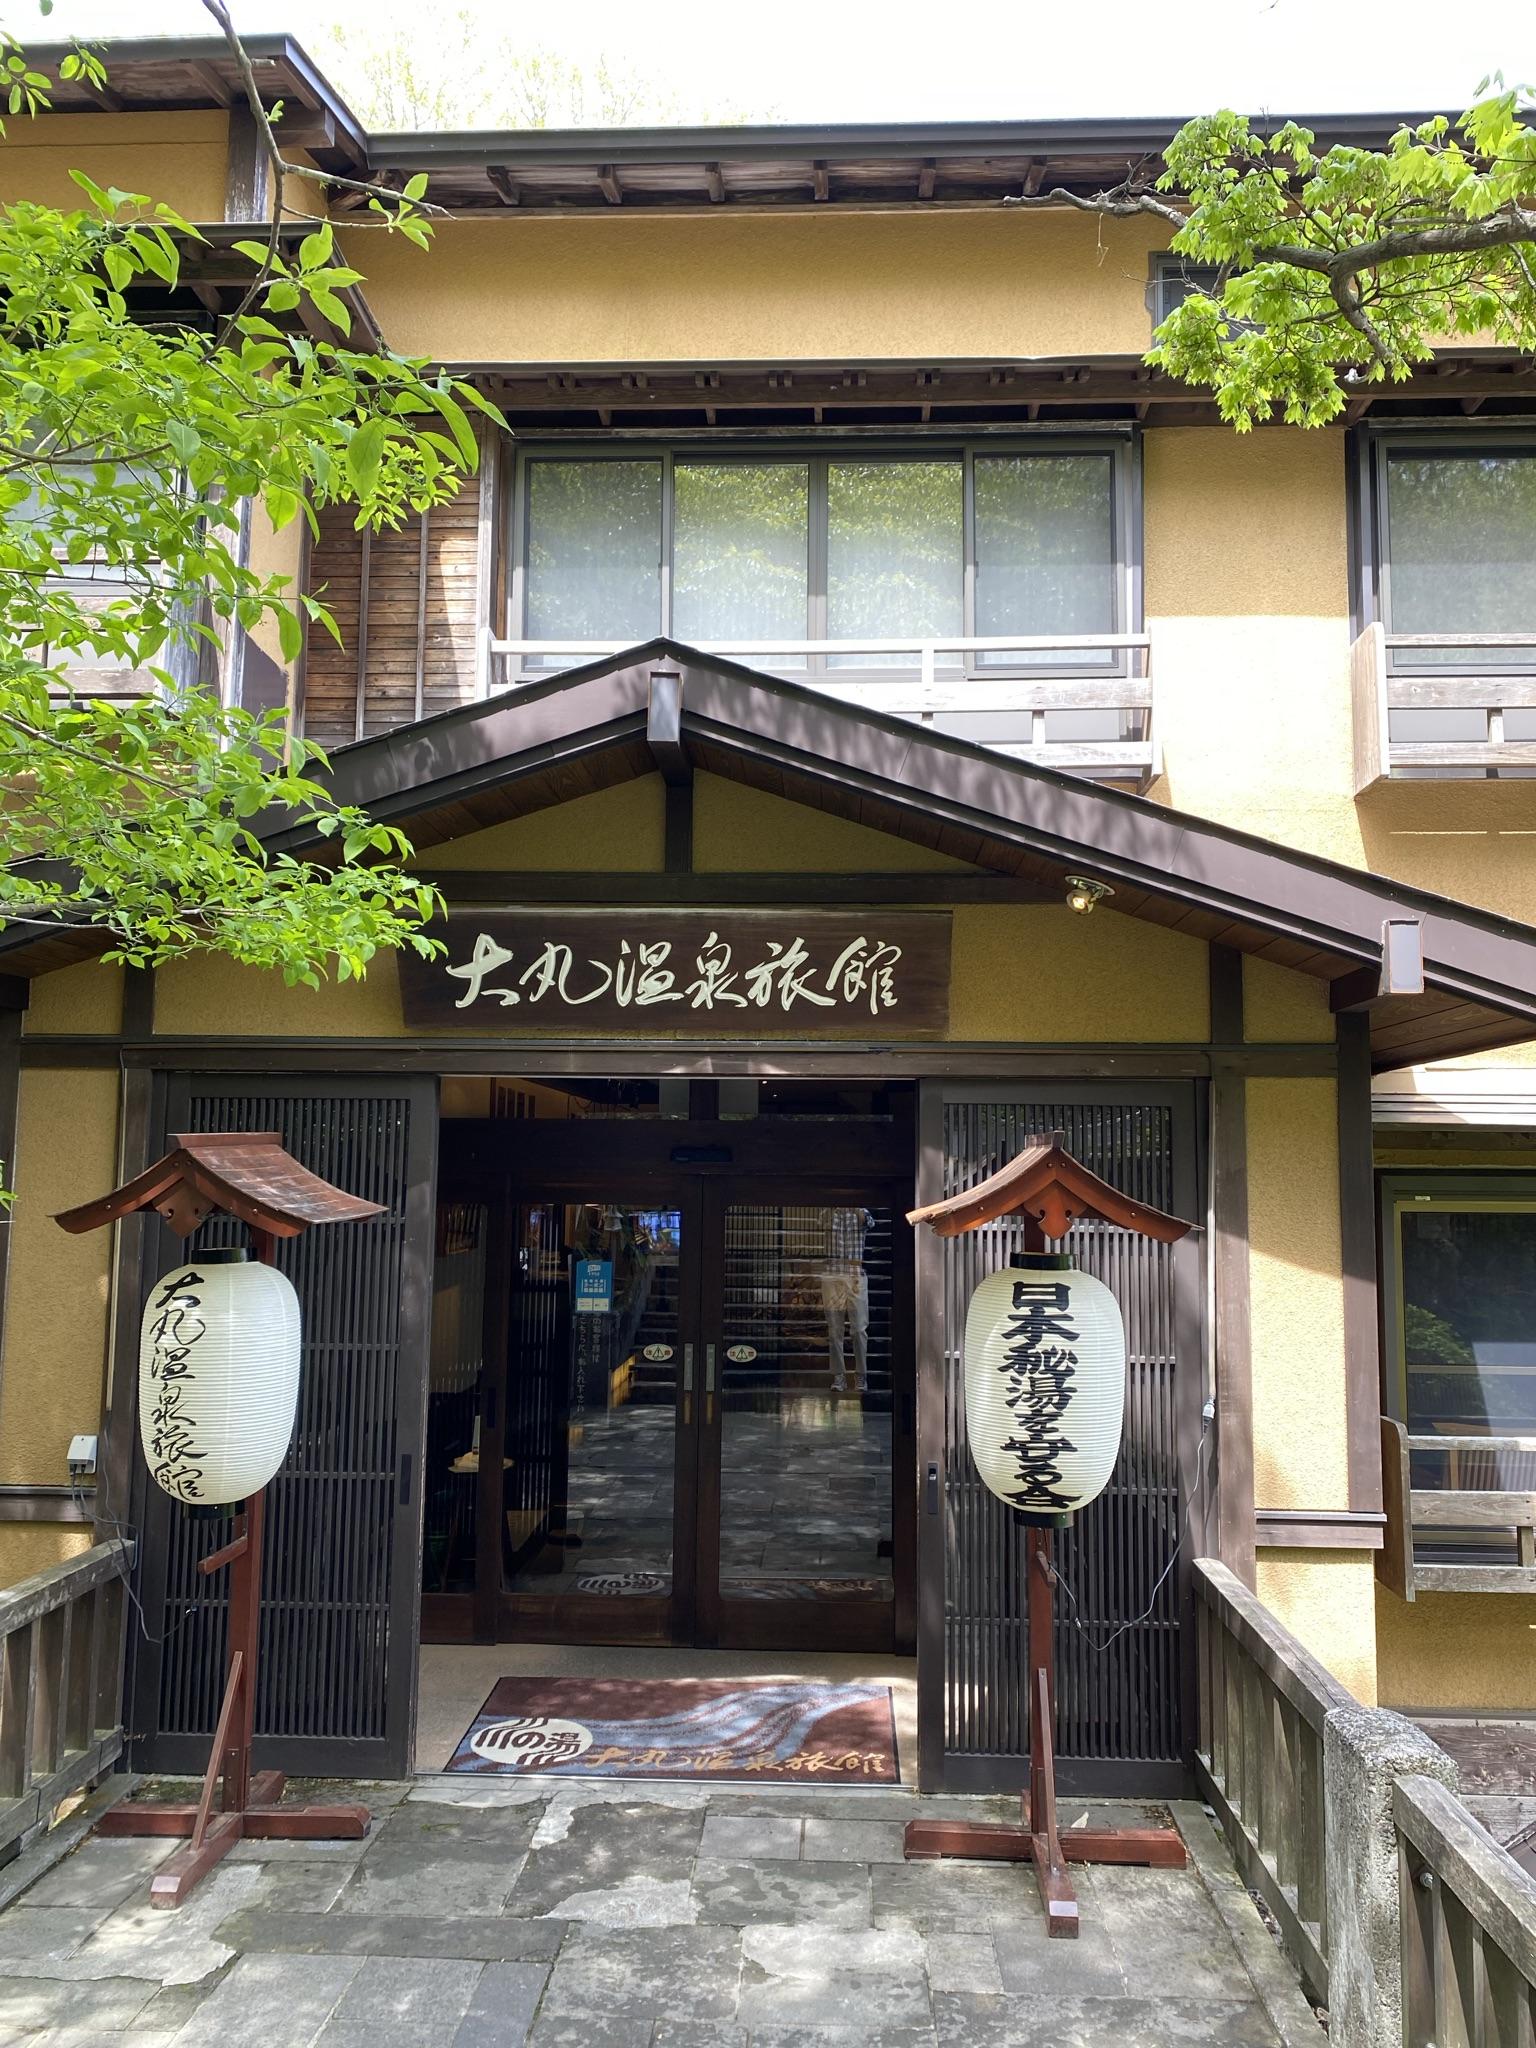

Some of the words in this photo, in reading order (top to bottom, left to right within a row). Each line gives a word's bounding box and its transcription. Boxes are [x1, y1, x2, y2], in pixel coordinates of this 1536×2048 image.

[445, 932, 902, 1015] 大丸温泉旅館
[149, 1271, 209, 1501] 大丸温泉旅館
[997, 1281, 1083, 1509] 日本秘湯を守る会
[584, 1746, 886, 1773] 大丸温泉旅館
